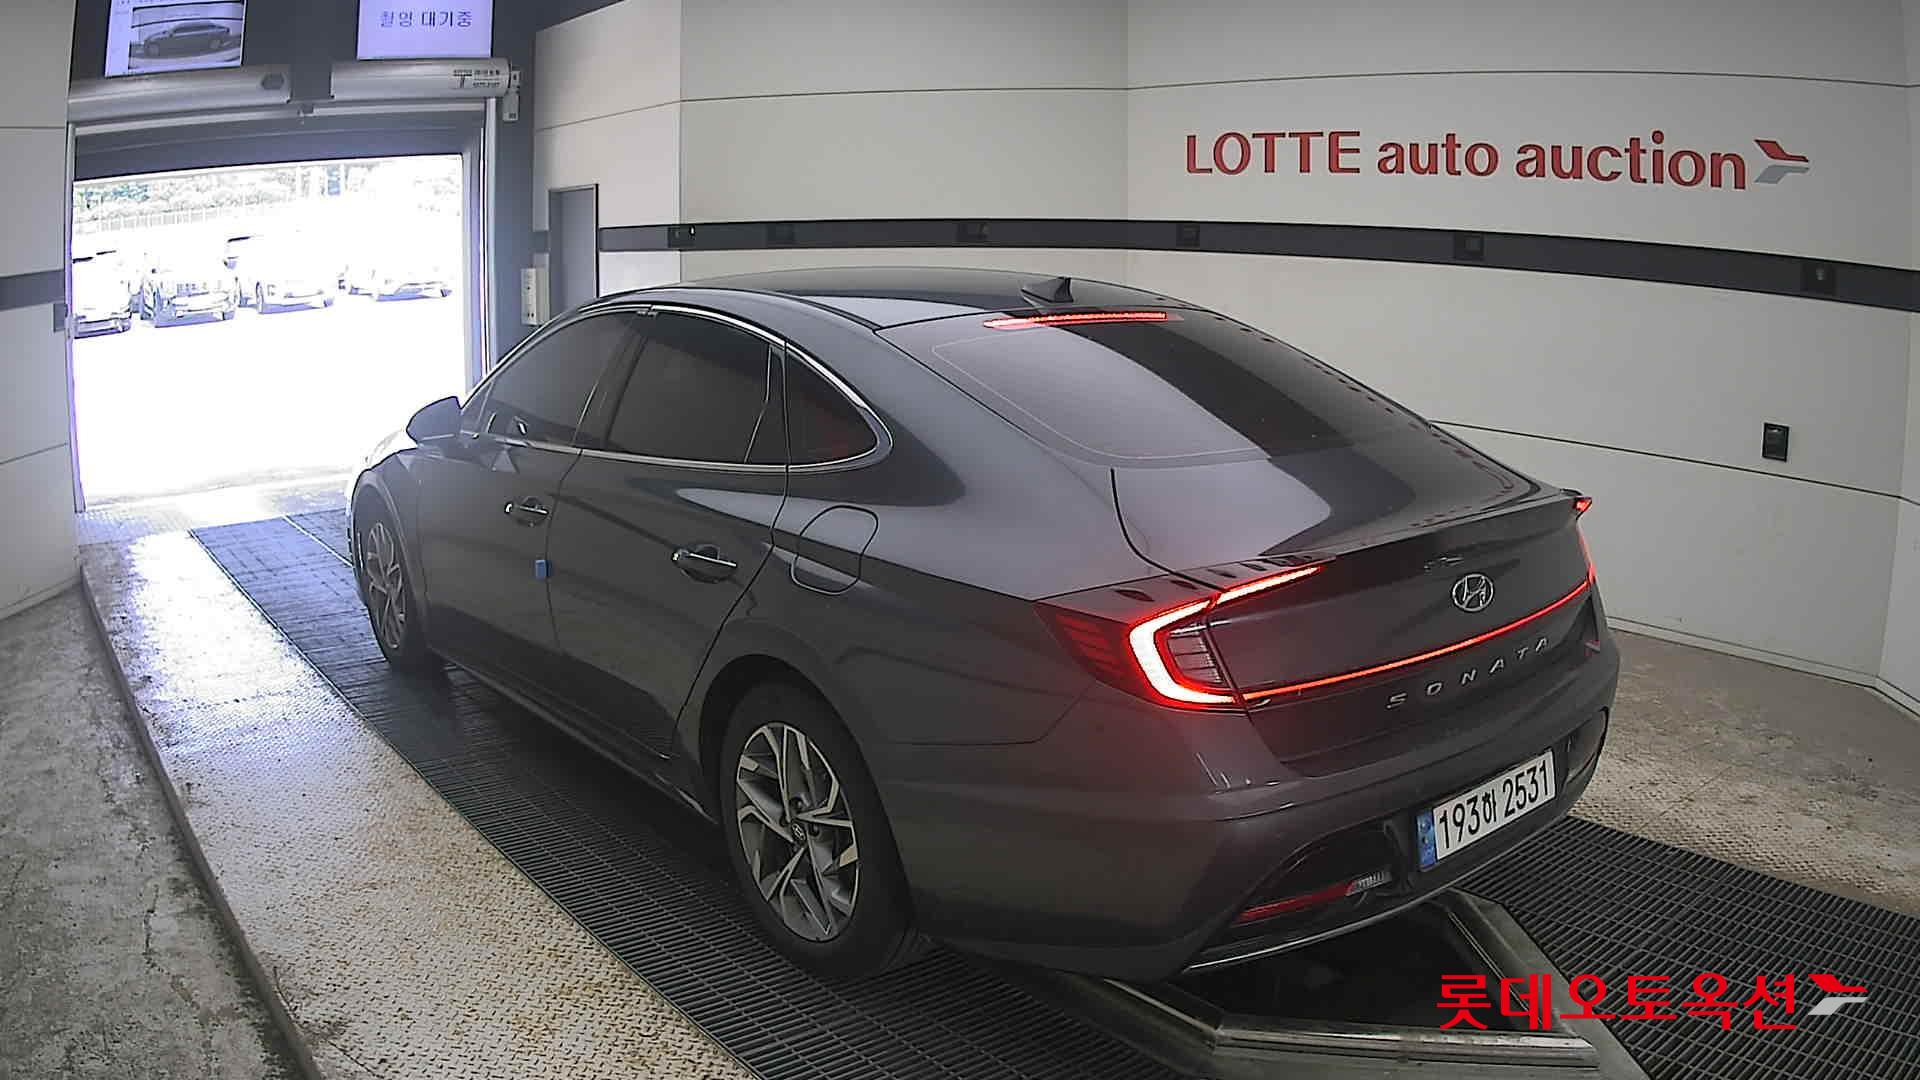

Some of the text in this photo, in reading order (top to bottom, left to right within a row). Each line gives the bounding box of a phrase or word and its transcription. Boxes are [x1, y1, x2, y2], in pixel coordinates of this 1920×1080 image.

[421, 11, 472, 28] 대기중
[1186, 130, 1746, 190] LOTTE auto auction
[1386, 636, 1549, 708] SONATA
[1439, 759, 1549, 849] 193하 2531
